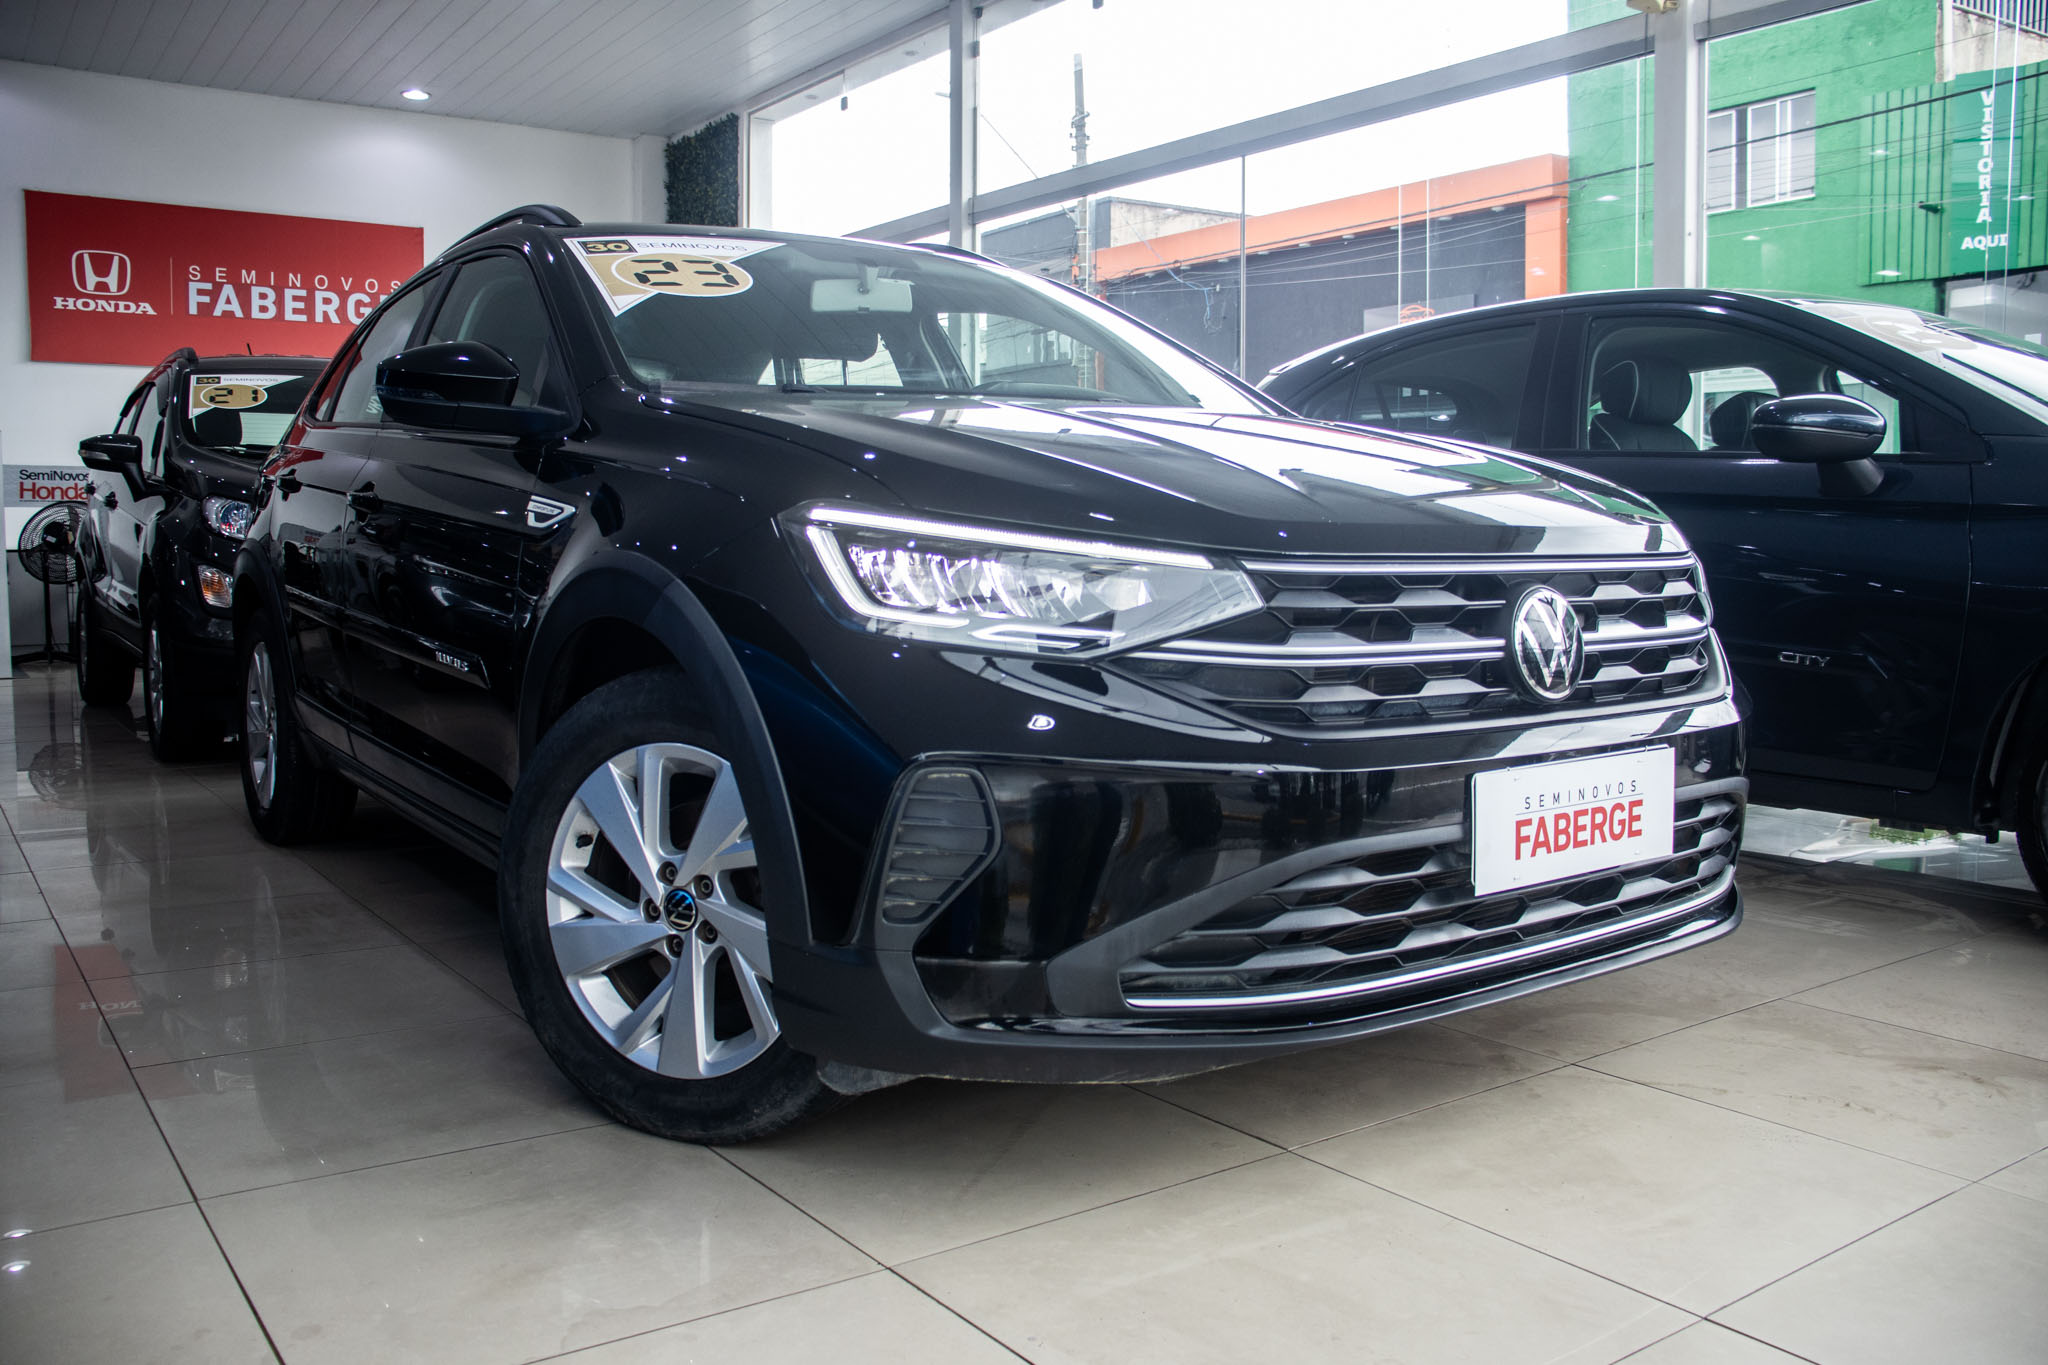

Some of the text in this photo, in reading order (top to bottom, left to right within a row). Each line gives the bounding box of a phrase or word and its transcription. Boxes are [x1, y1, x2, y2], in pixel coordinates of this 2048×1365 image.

[1975, 90, 1994, 224] VISTORIA
[586, 241, 748, 252] 30 SEMINOVOS
[1960, 233, 2009, 250] AQUI
[630, 258, 740, 288] 23
[53, 296, 158, 316] HONDA
[188, 281, 390, 326] FABERG
[208, 387, 259, 404] 21
[18, 481, 90, 501] Honda
[1779, 651, 1831, 667] CITY
[1524, 779, 1638, 810] SEMINOVOS
[1514, 799, 1644, 861] FABERGE
